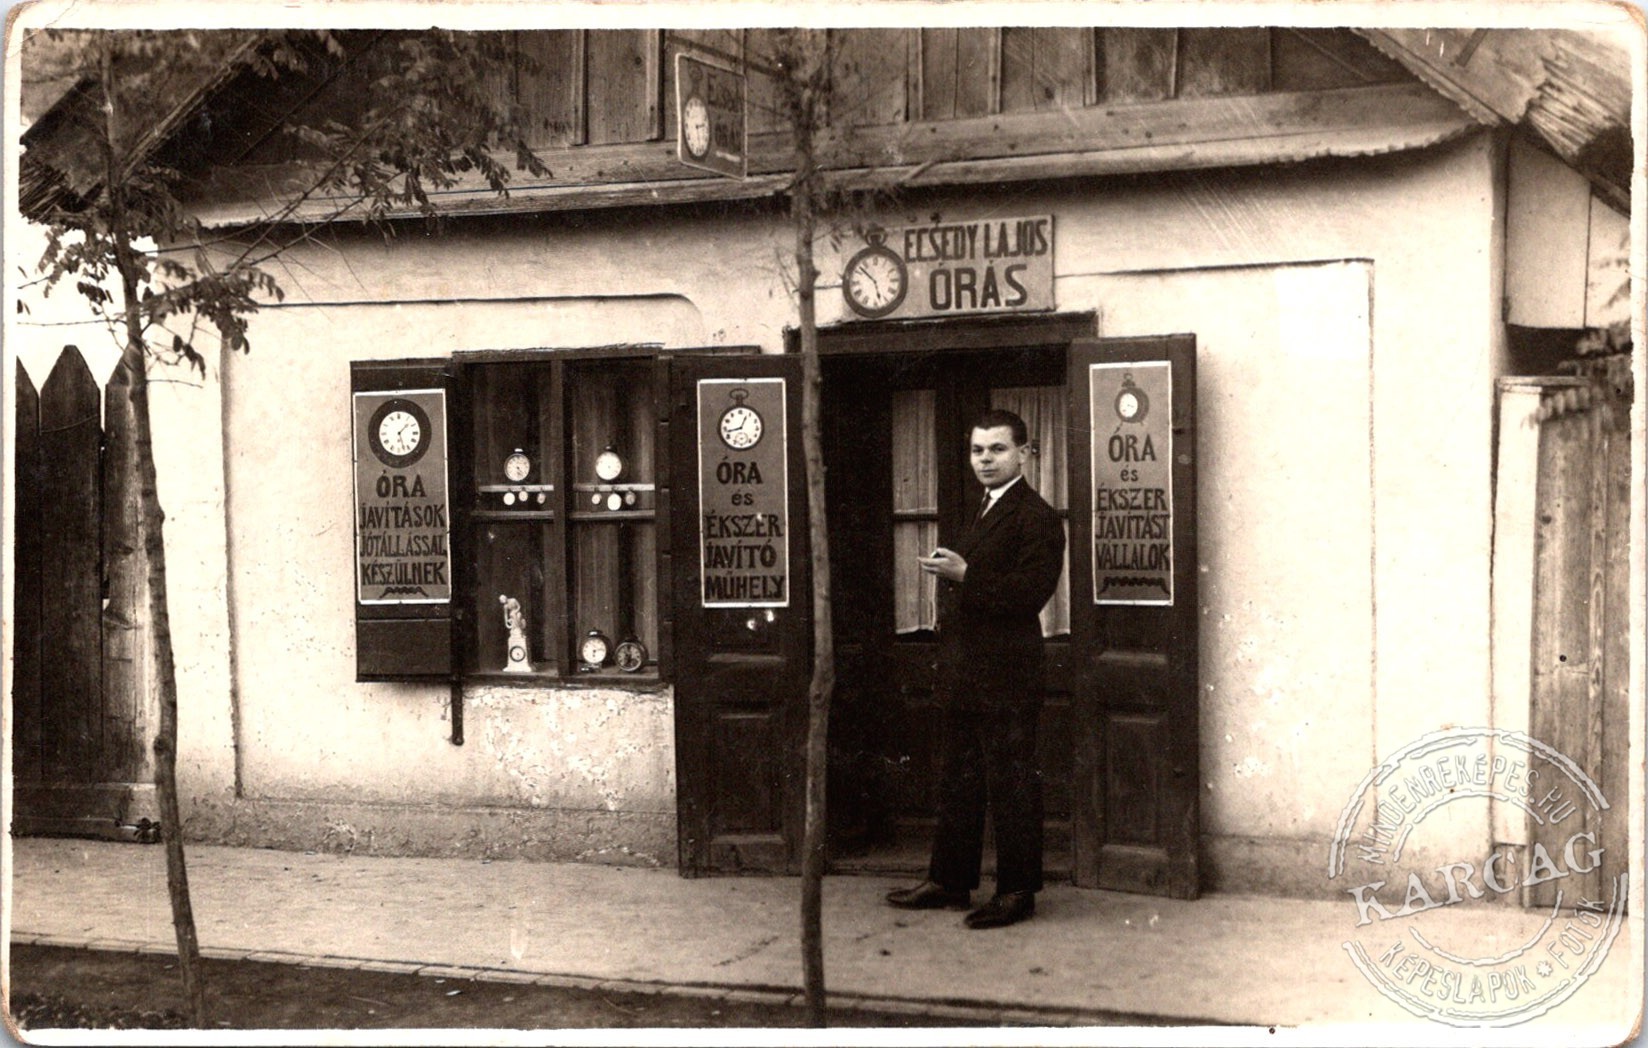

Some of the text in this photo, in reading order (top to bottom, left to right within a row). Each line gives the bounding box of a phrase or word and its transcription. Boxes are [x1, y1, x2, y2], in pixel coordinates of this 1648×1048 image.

[904, 218, 1050, 263] ECSEDY LAJOS
[928, 259, 1029, 311] ÓRÁS
[1107, 426, 1157, 463] ÓRA
[375, 469, 427, 498] ÓRA
[716, 455, 764, 485] ÓRA
[1120, 464, 1139, 482] és
[731, 489, 755, 506] és
[1096, 482, 1168, 511] ÉKSZER
[359, 500, 446, 529] JAVÍTÁSOK
[705, 509, 784, 538] ÉKSZER
[360, 530, 448, 558] JÓTÁLLÁSSAL
[704, 539, 778, 570] JAVÍTÓ
[361, 559, 448, 585] KÉSZÜLNEK
